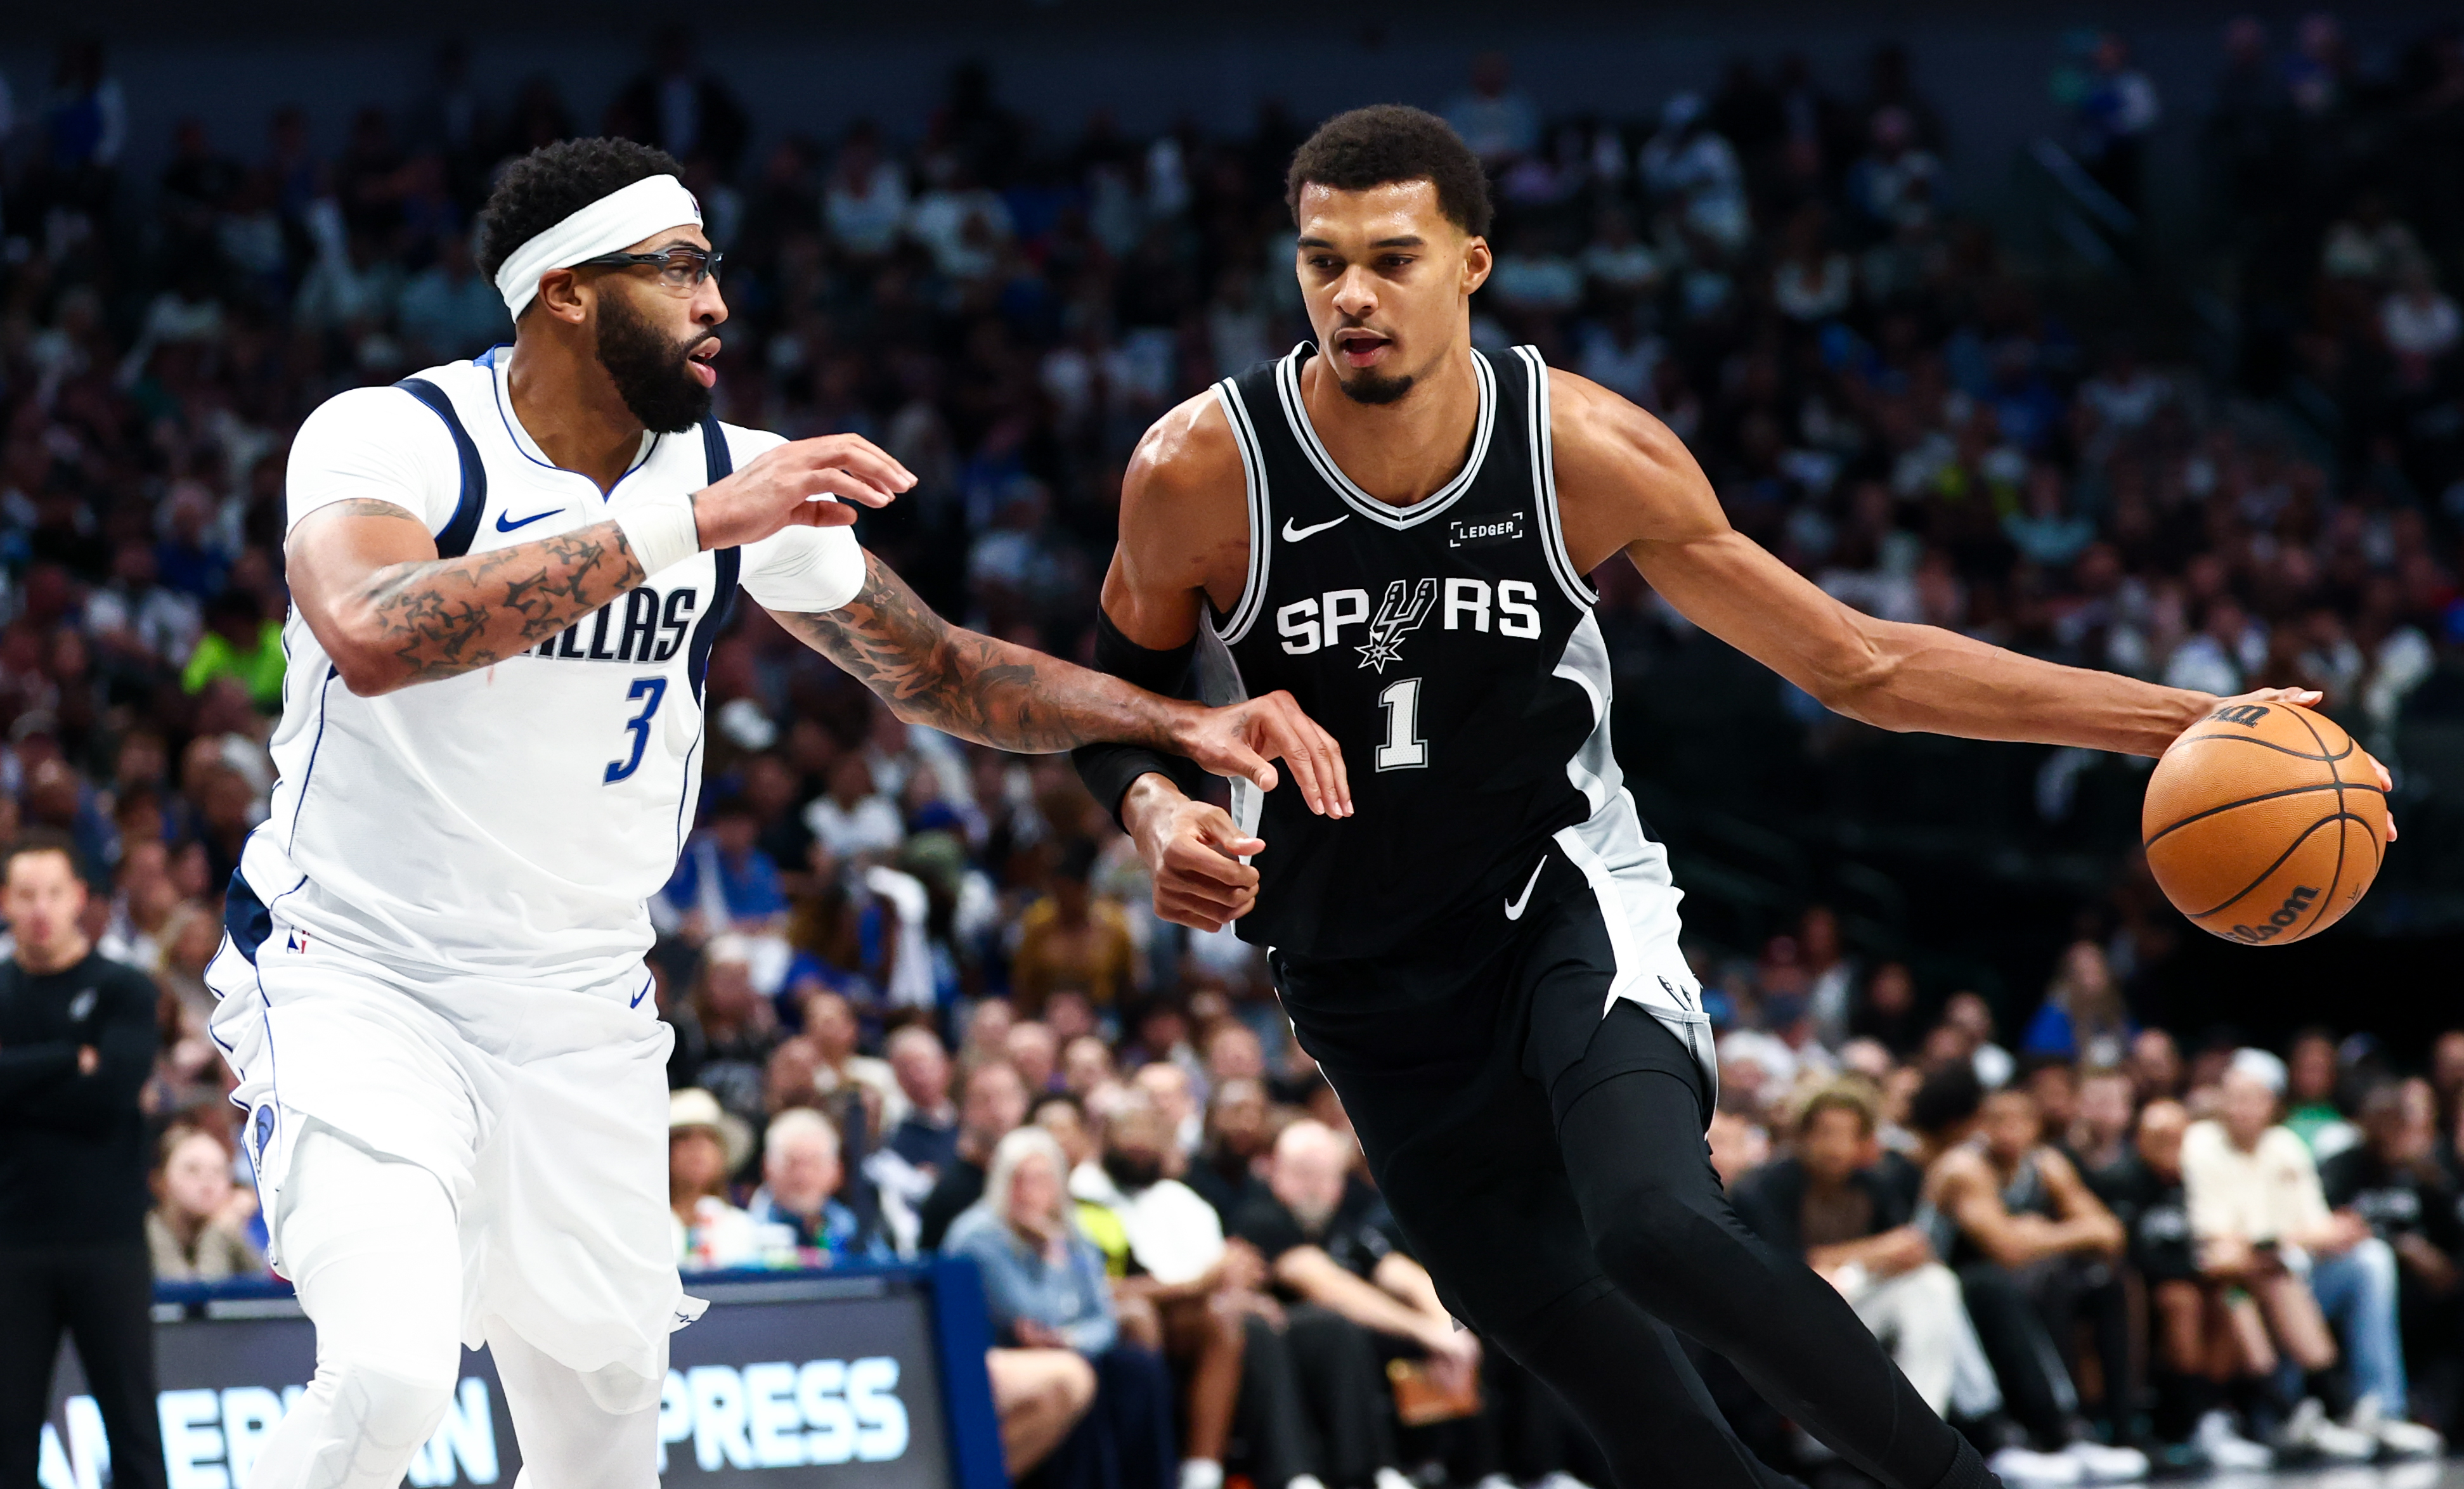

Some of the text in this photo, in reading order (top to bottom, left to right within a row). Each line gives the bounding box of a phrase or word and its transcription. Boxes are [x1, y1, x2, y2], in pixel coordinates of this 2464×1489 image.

[1460, 521, 1514, 539] LEDGER
[517, 584, 697, 664] LLAS
[1277, 577, 1541, 674] SPURS
[602, 674, 668, 787] 3
[1375, 677, 1428, 773] 1
[656, 1356, 909, 1475] PRESS
